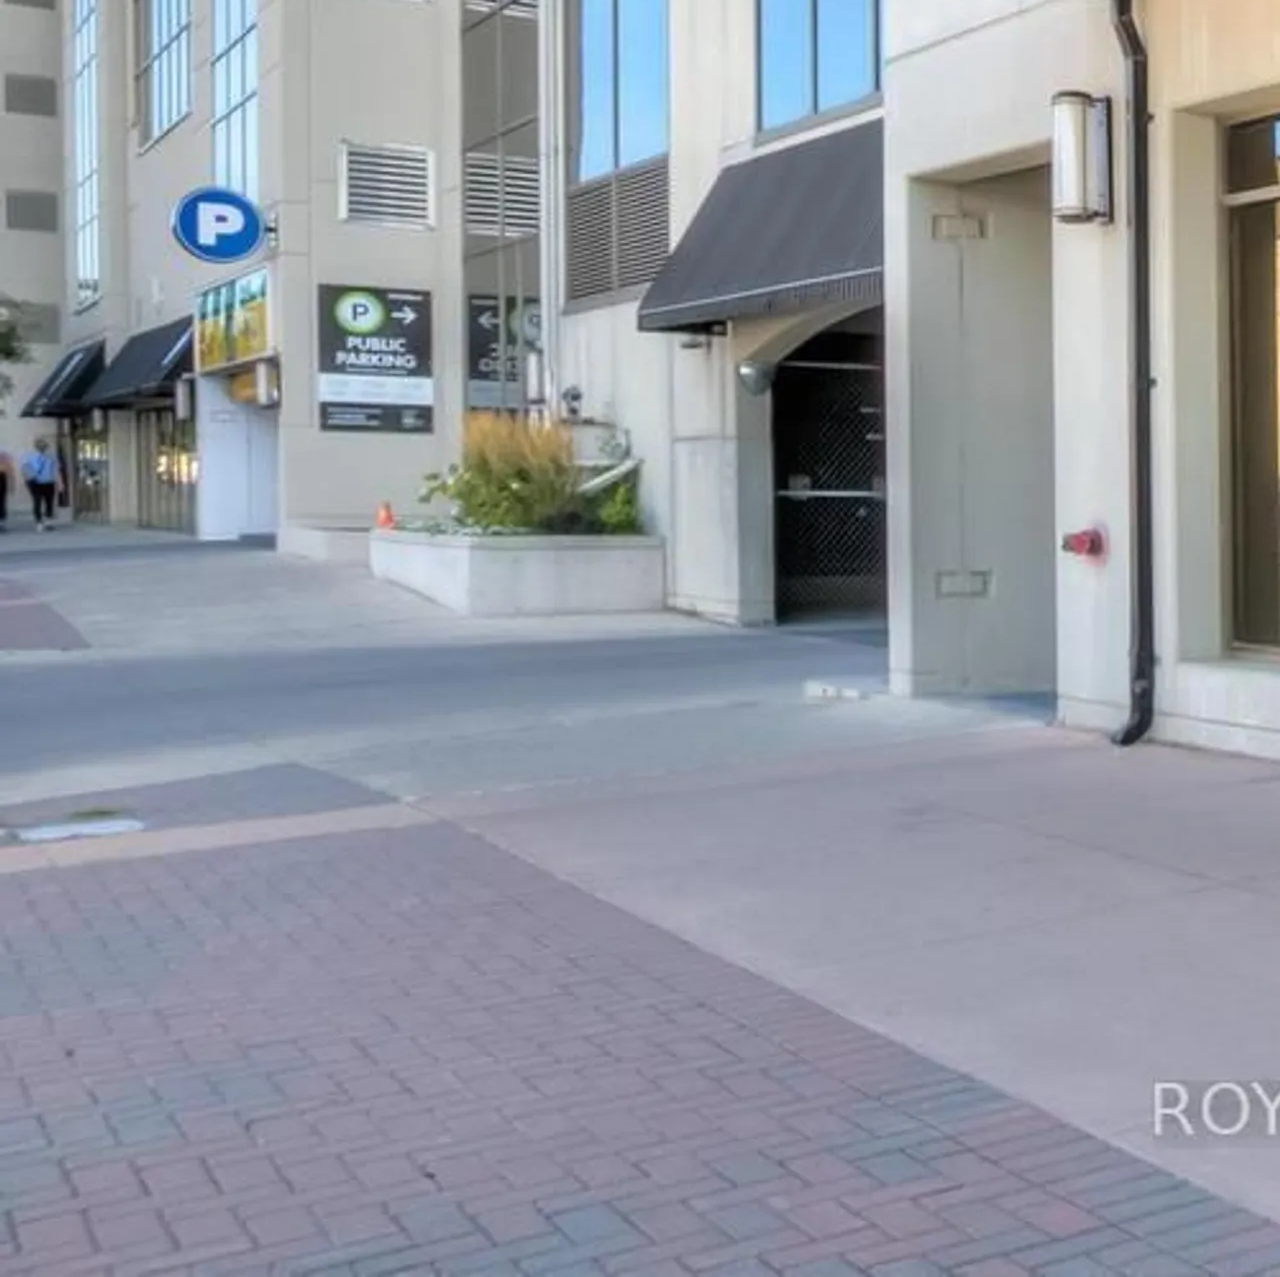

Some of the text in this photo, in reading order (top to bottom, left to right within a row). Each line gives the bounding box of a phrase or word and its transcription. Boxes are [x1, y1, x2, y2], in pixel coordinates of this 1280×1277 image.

[198, 202, 244, 246] P
[352, 303, 370, 321] P
[346, 336, 408, 353] PUBLIC
[335, 351, 418, 369] PARKING
